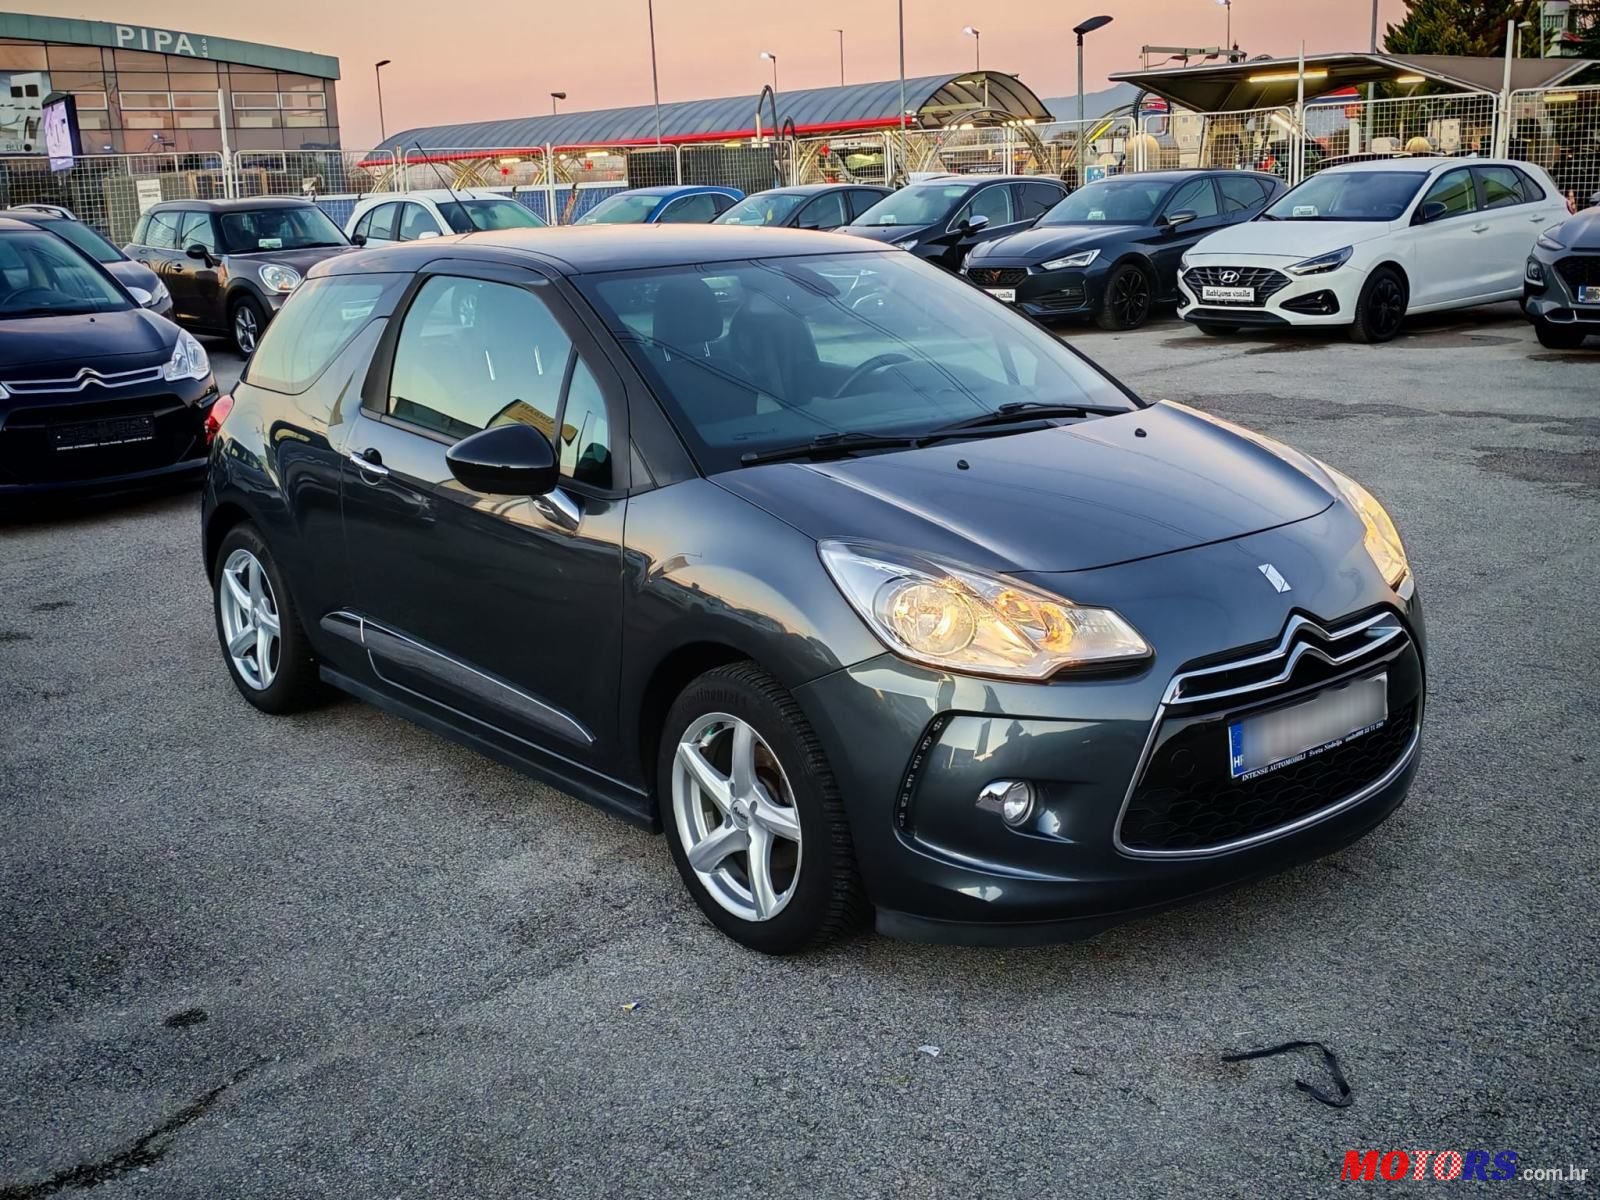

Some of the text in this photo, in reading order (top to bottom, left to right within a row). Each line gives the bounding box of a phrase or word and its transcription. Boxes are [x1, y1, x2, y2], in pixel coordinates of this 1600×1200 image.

[116, 25, 196, 56] PIPA
[1242, 766, 1269, 782] INTENSE
[1269, 752, 1306, 772] AUTOMOBILI
